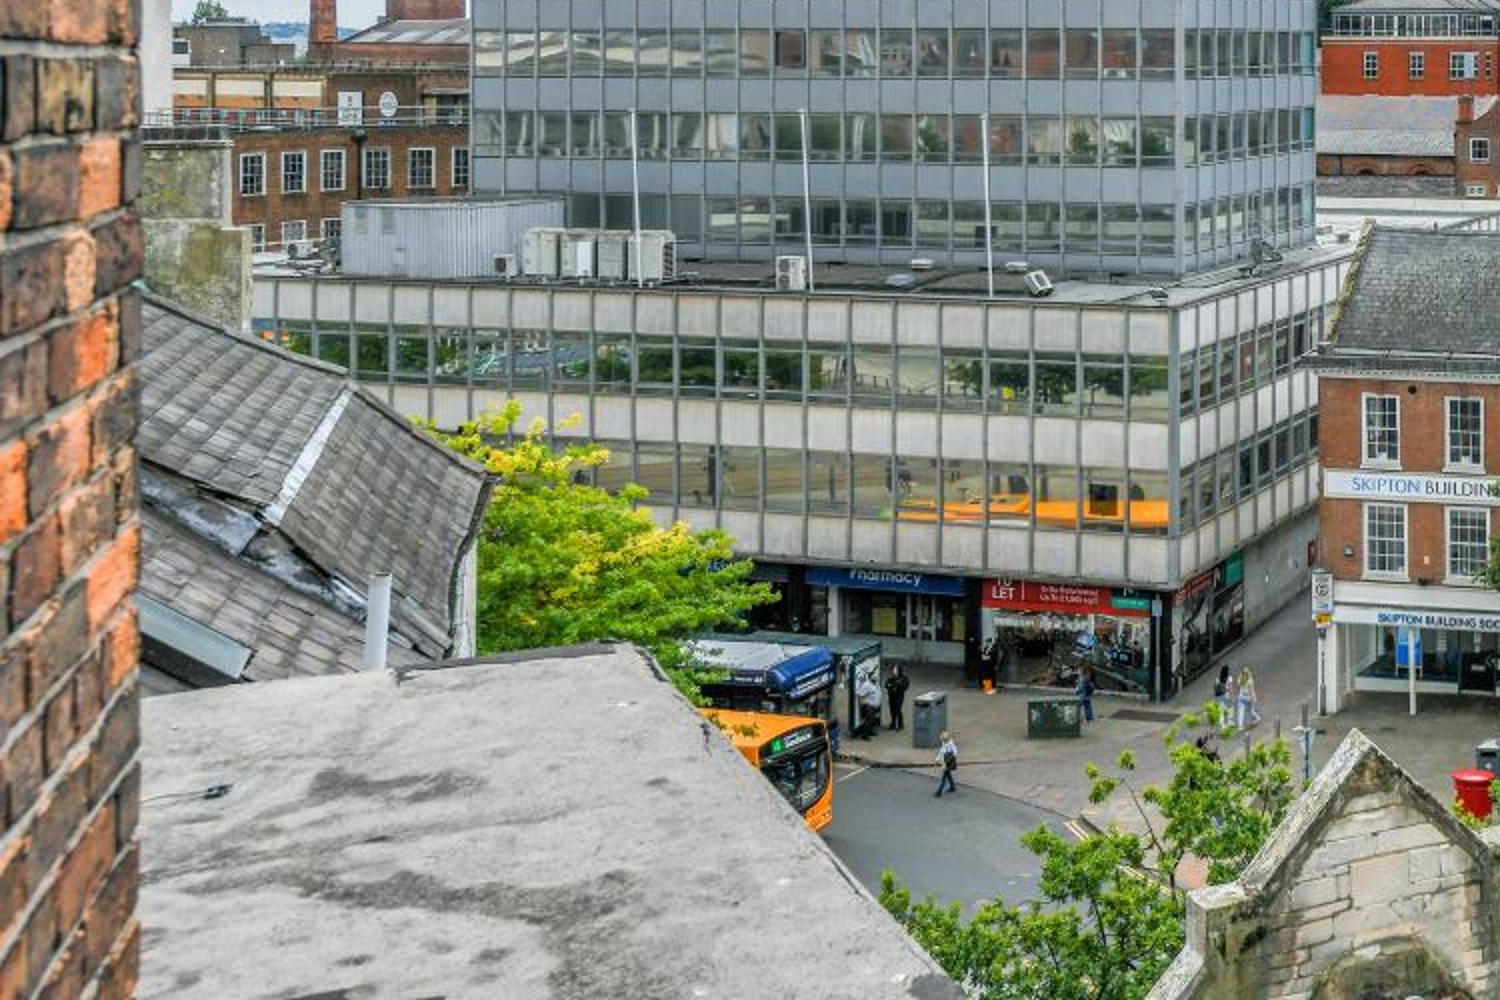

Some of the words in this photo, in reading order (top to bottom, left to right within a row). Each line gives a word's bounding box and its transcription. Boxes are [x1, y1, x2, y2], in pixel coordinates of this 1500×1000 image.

[1351, 476, 1420, 494] SKIPTON
[1425, 480, 1498, 498] BUILDIN
[991, 586, 1015, 600] LET
[1377, 612, 1423, 625] SKIPTON
[1425, 615, 1477, 630] BUILDING
